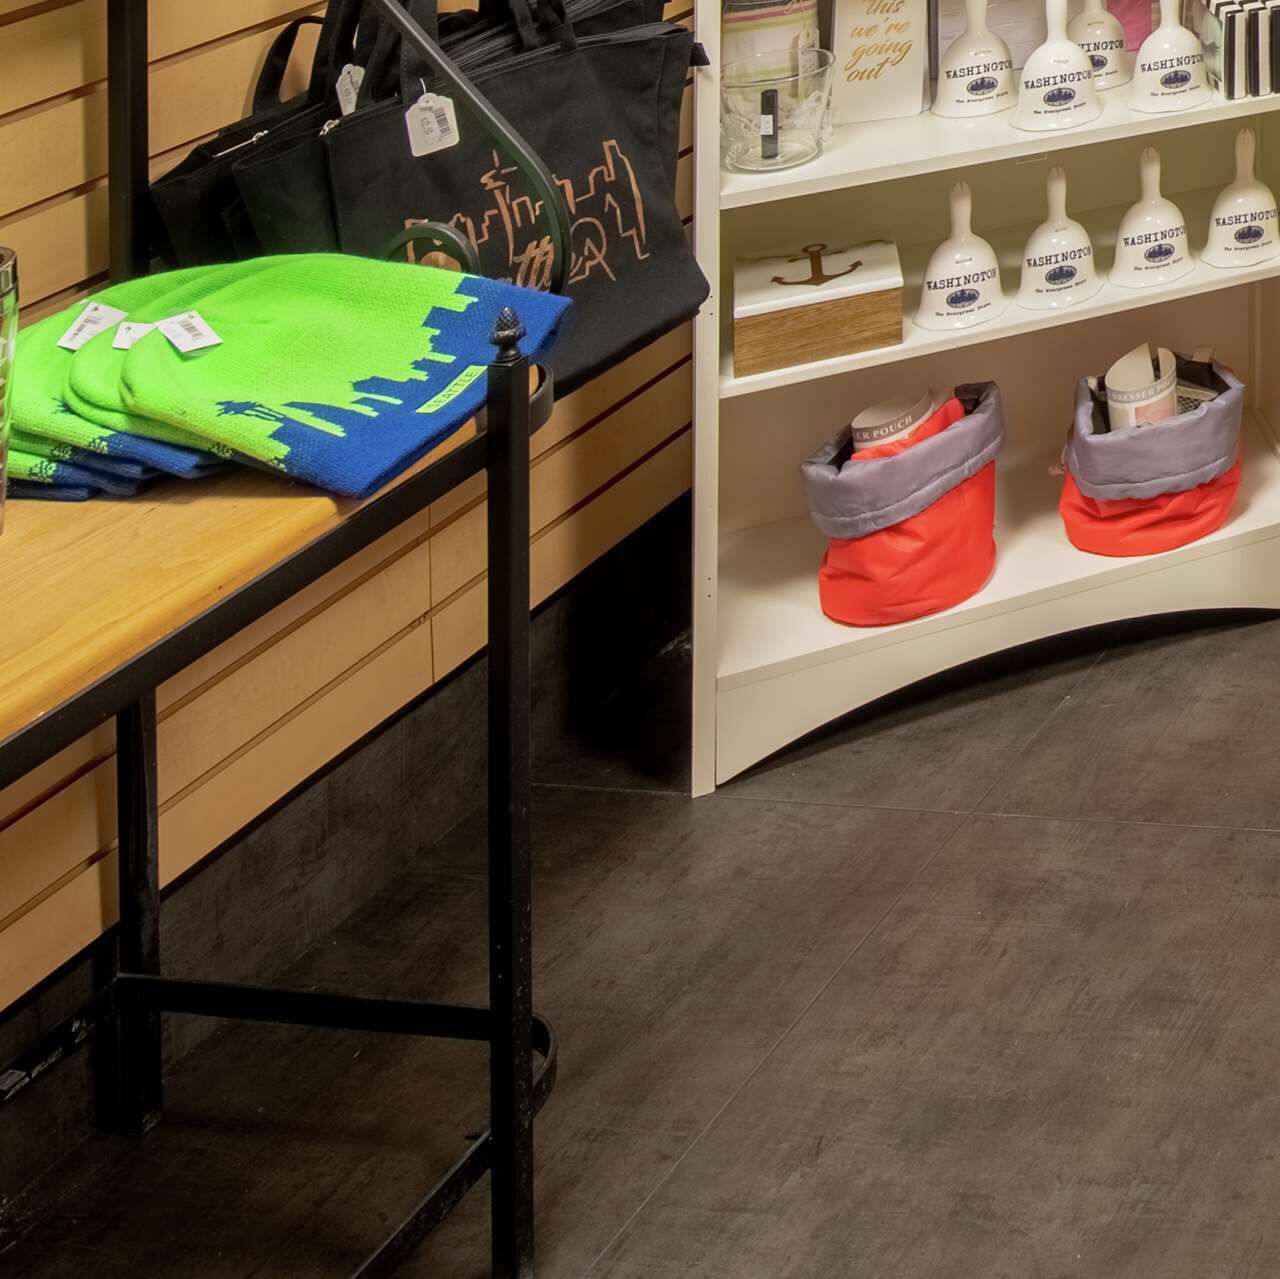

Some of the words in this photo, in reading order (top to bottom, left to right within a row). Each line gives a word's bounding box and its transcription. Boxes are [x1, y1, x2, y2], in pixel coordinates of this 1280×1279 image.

[850, 17, 911, 38] we're
[845, 39, 912, 71] going
[846, 57, 895, 82] out
[425, 369, 479, 410] SEATTLE
[873, 416, 913, 439] POUCH
